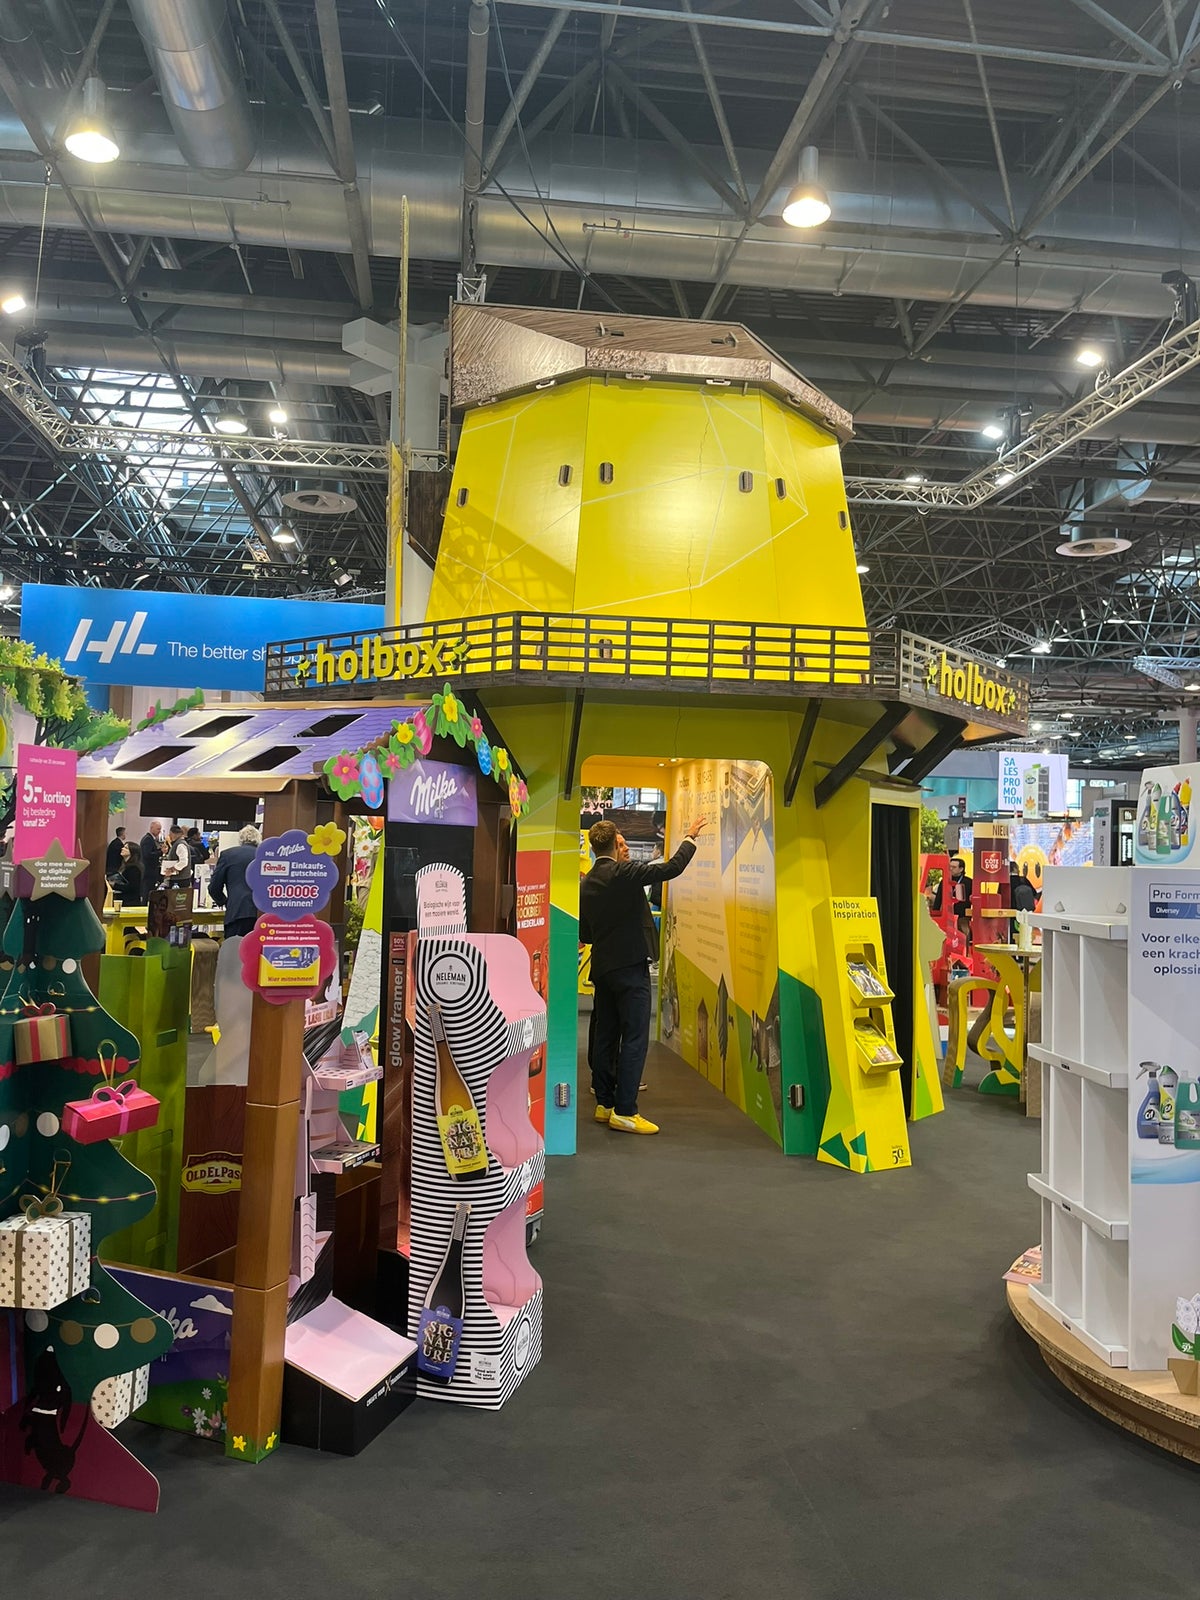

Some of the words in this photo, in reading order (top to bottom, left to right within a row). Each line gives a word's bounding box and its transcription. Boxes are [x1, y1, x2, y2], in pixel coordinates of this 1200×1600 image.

[167, 641, 198, 657] The
[202, 642, 248, 661] better
[316, 635, 446, 683] holbox
[940, 651, 1007, 714] holbox
[1004, 757, 1016, 766] SA
[1004, 767, 1019, 776] LES
[1003, 777, 1021, 786] PRO
[410, 770, 457, 816] Milka
[1003, 788, 1017, 796] MO
[43, 791, 71, 807] korting
[1003, 796, 1022, 805] TION
[593, 802, 613, 810] you
[31, 808, 56, 819] besteding
[277, 843, 306, 857] Milka
[263, 862, 287, 872] famila
[291, 861, 327, 870] Einkaufs-
[267, 884, 319, 899] 10.000€
[1152, 889, 1172, 899] Pro
[272, 900, 314, 908] gewinnen!
[524, 893, 546, 905] OUDSTE
[832, 900, 860, 909] holbox
[833, 910, 877, 920] Inspiration
[1155, 906, 1180, 915] Diversey
[1141, 932, 1171, 943] Voor
[1173, 933, 1200, 944] elke
[1142, 950, 1165, 959] een
[435, 972, 467, 982] NELEMAN
[390, 968, 404, 1023] framer
[389, 1026, 403, 1067] glow
[892, 1148, 904, 1164] 50
[186, 1170, 206, 1182] OLD
[207, 1166, 220, 1177] EL
[430, 1321, 453, 1337] SIG
[424, 1331, 453, 1350] NAT
[423, 1344, 451, 1362] URE
